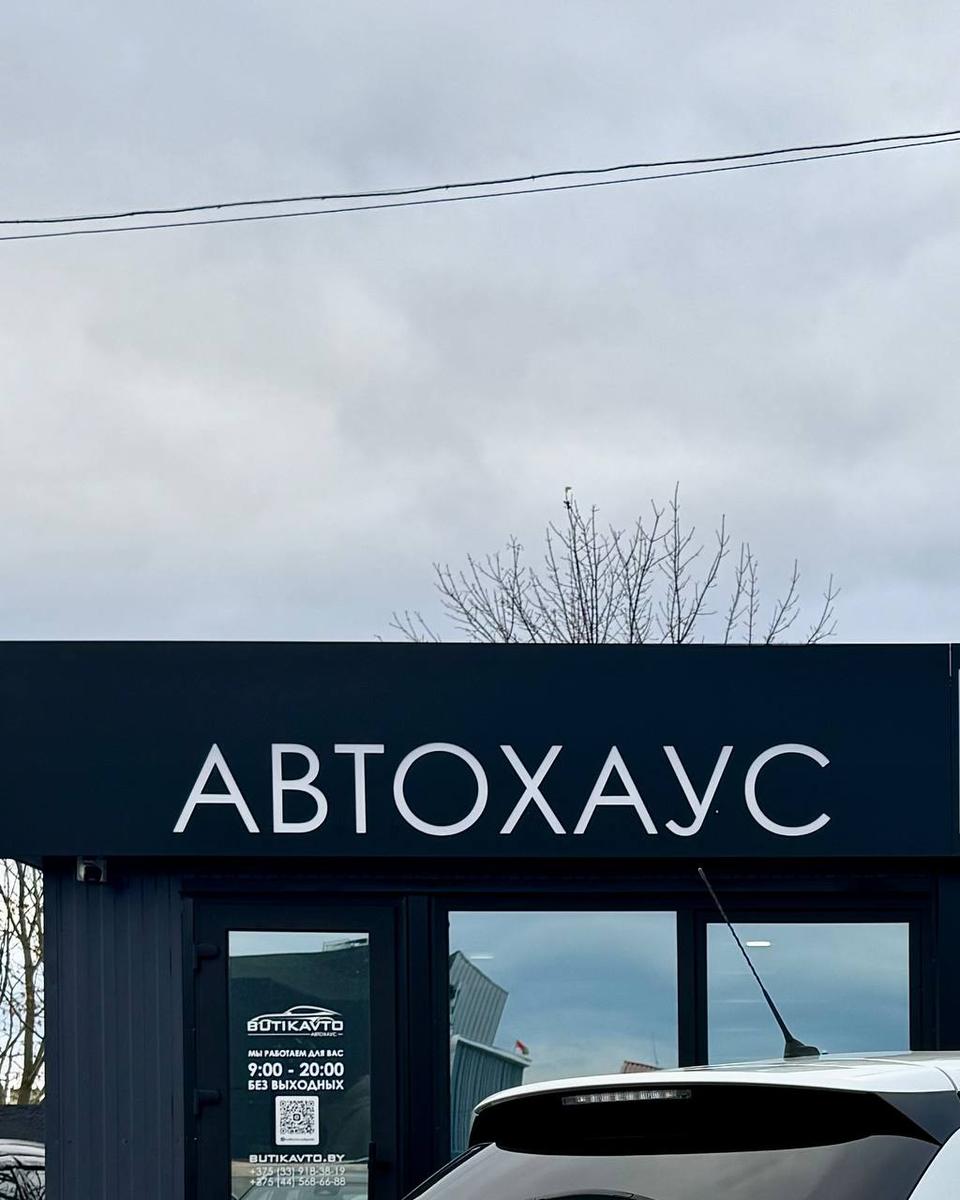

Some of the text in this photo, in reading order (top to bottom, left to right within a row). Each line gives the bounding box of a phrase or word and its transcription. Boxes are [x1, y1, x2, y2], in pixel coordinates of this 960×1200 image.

[172, 741, 832, 837] АВТОХАУС
[247, 1020, 344, 1032] BUTIKAVTO
[264, 1050, 307, 1058] РАБОТАЕМ
[308, 1050, 325, 1058] ДЛЯ
[248, 1062, 282, 1077] 9:00
[300, 1062, 344, 1077] 20:00
[248, 1080, 344, 1091] БЕЗ ВЫХОДНЫХ
[250, 1154, 345, 1163] BUTIKAVTO.BY
